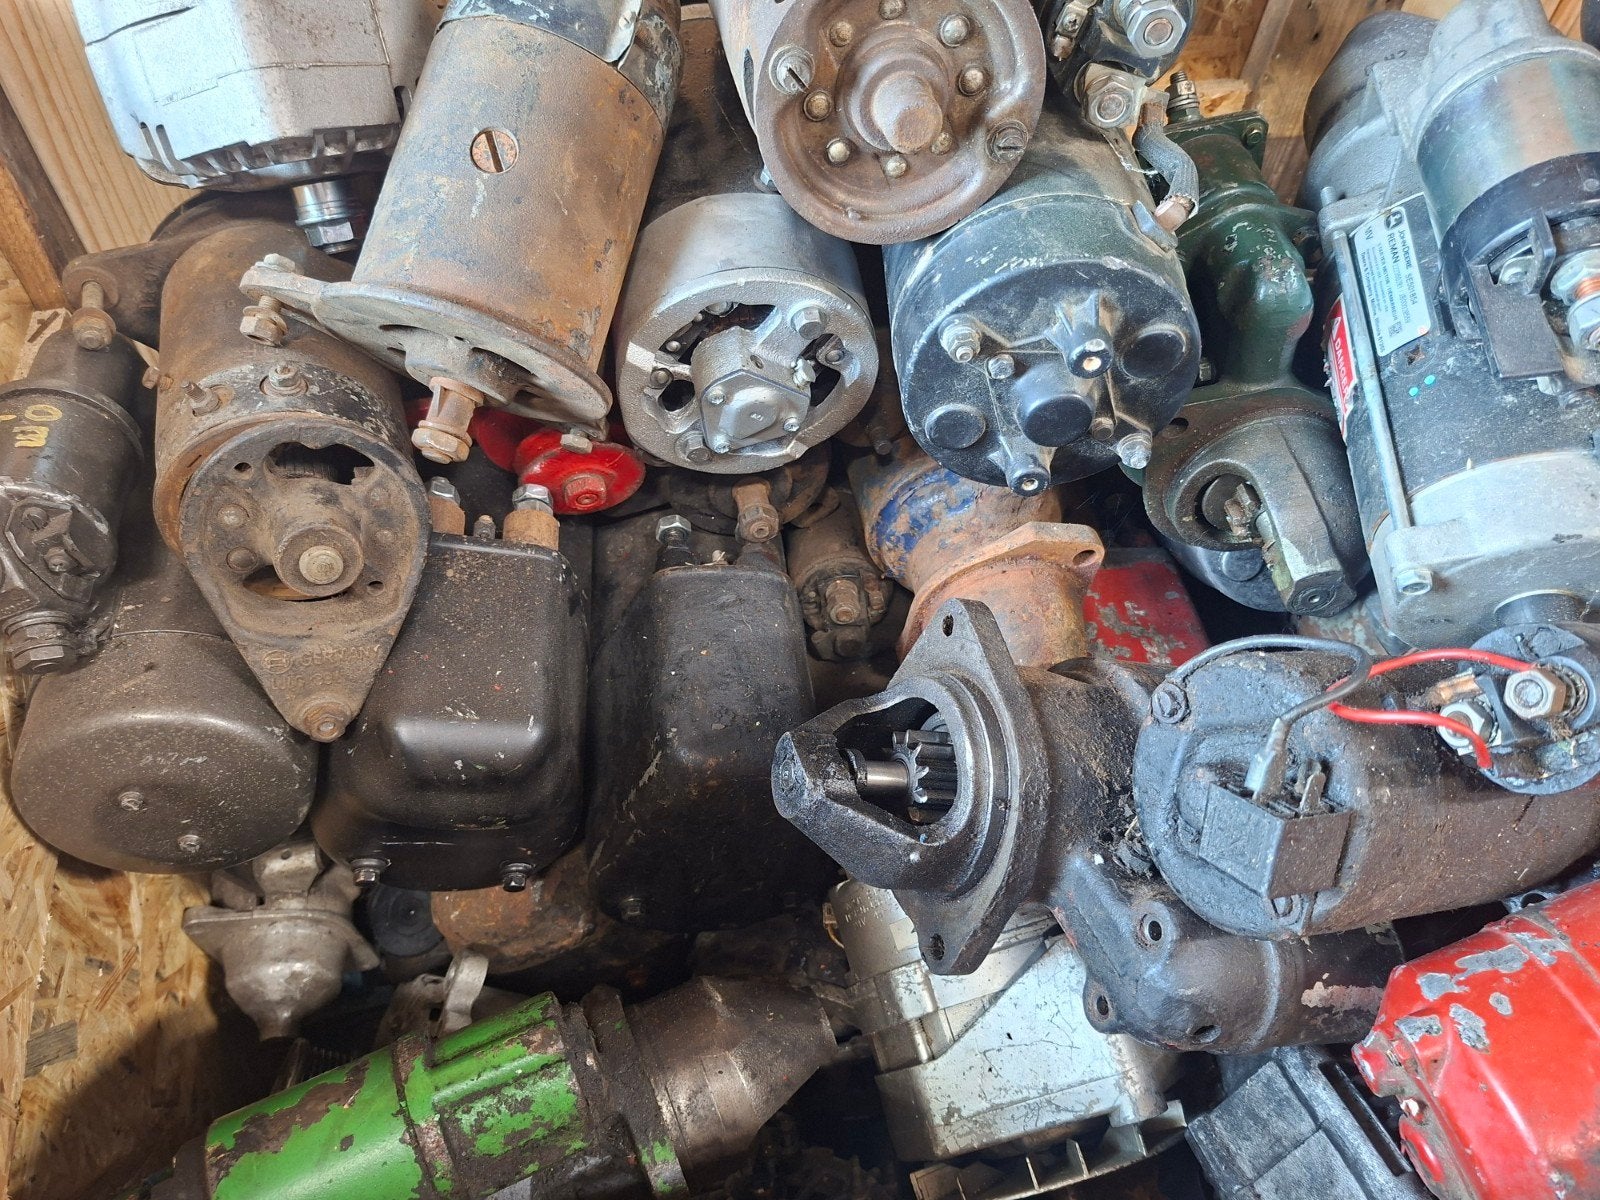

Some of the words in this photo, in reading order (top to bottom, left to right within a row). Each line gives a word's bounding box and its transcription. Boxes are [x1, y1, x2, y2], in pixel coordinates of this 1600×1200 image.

[1387, 232, 1399, 264] REMAN
[1399, 229, 1408, 248] JOHN
[1401, 245, 1413, 270] DEERE
[1335, 337, 1350, 397] DANGER
